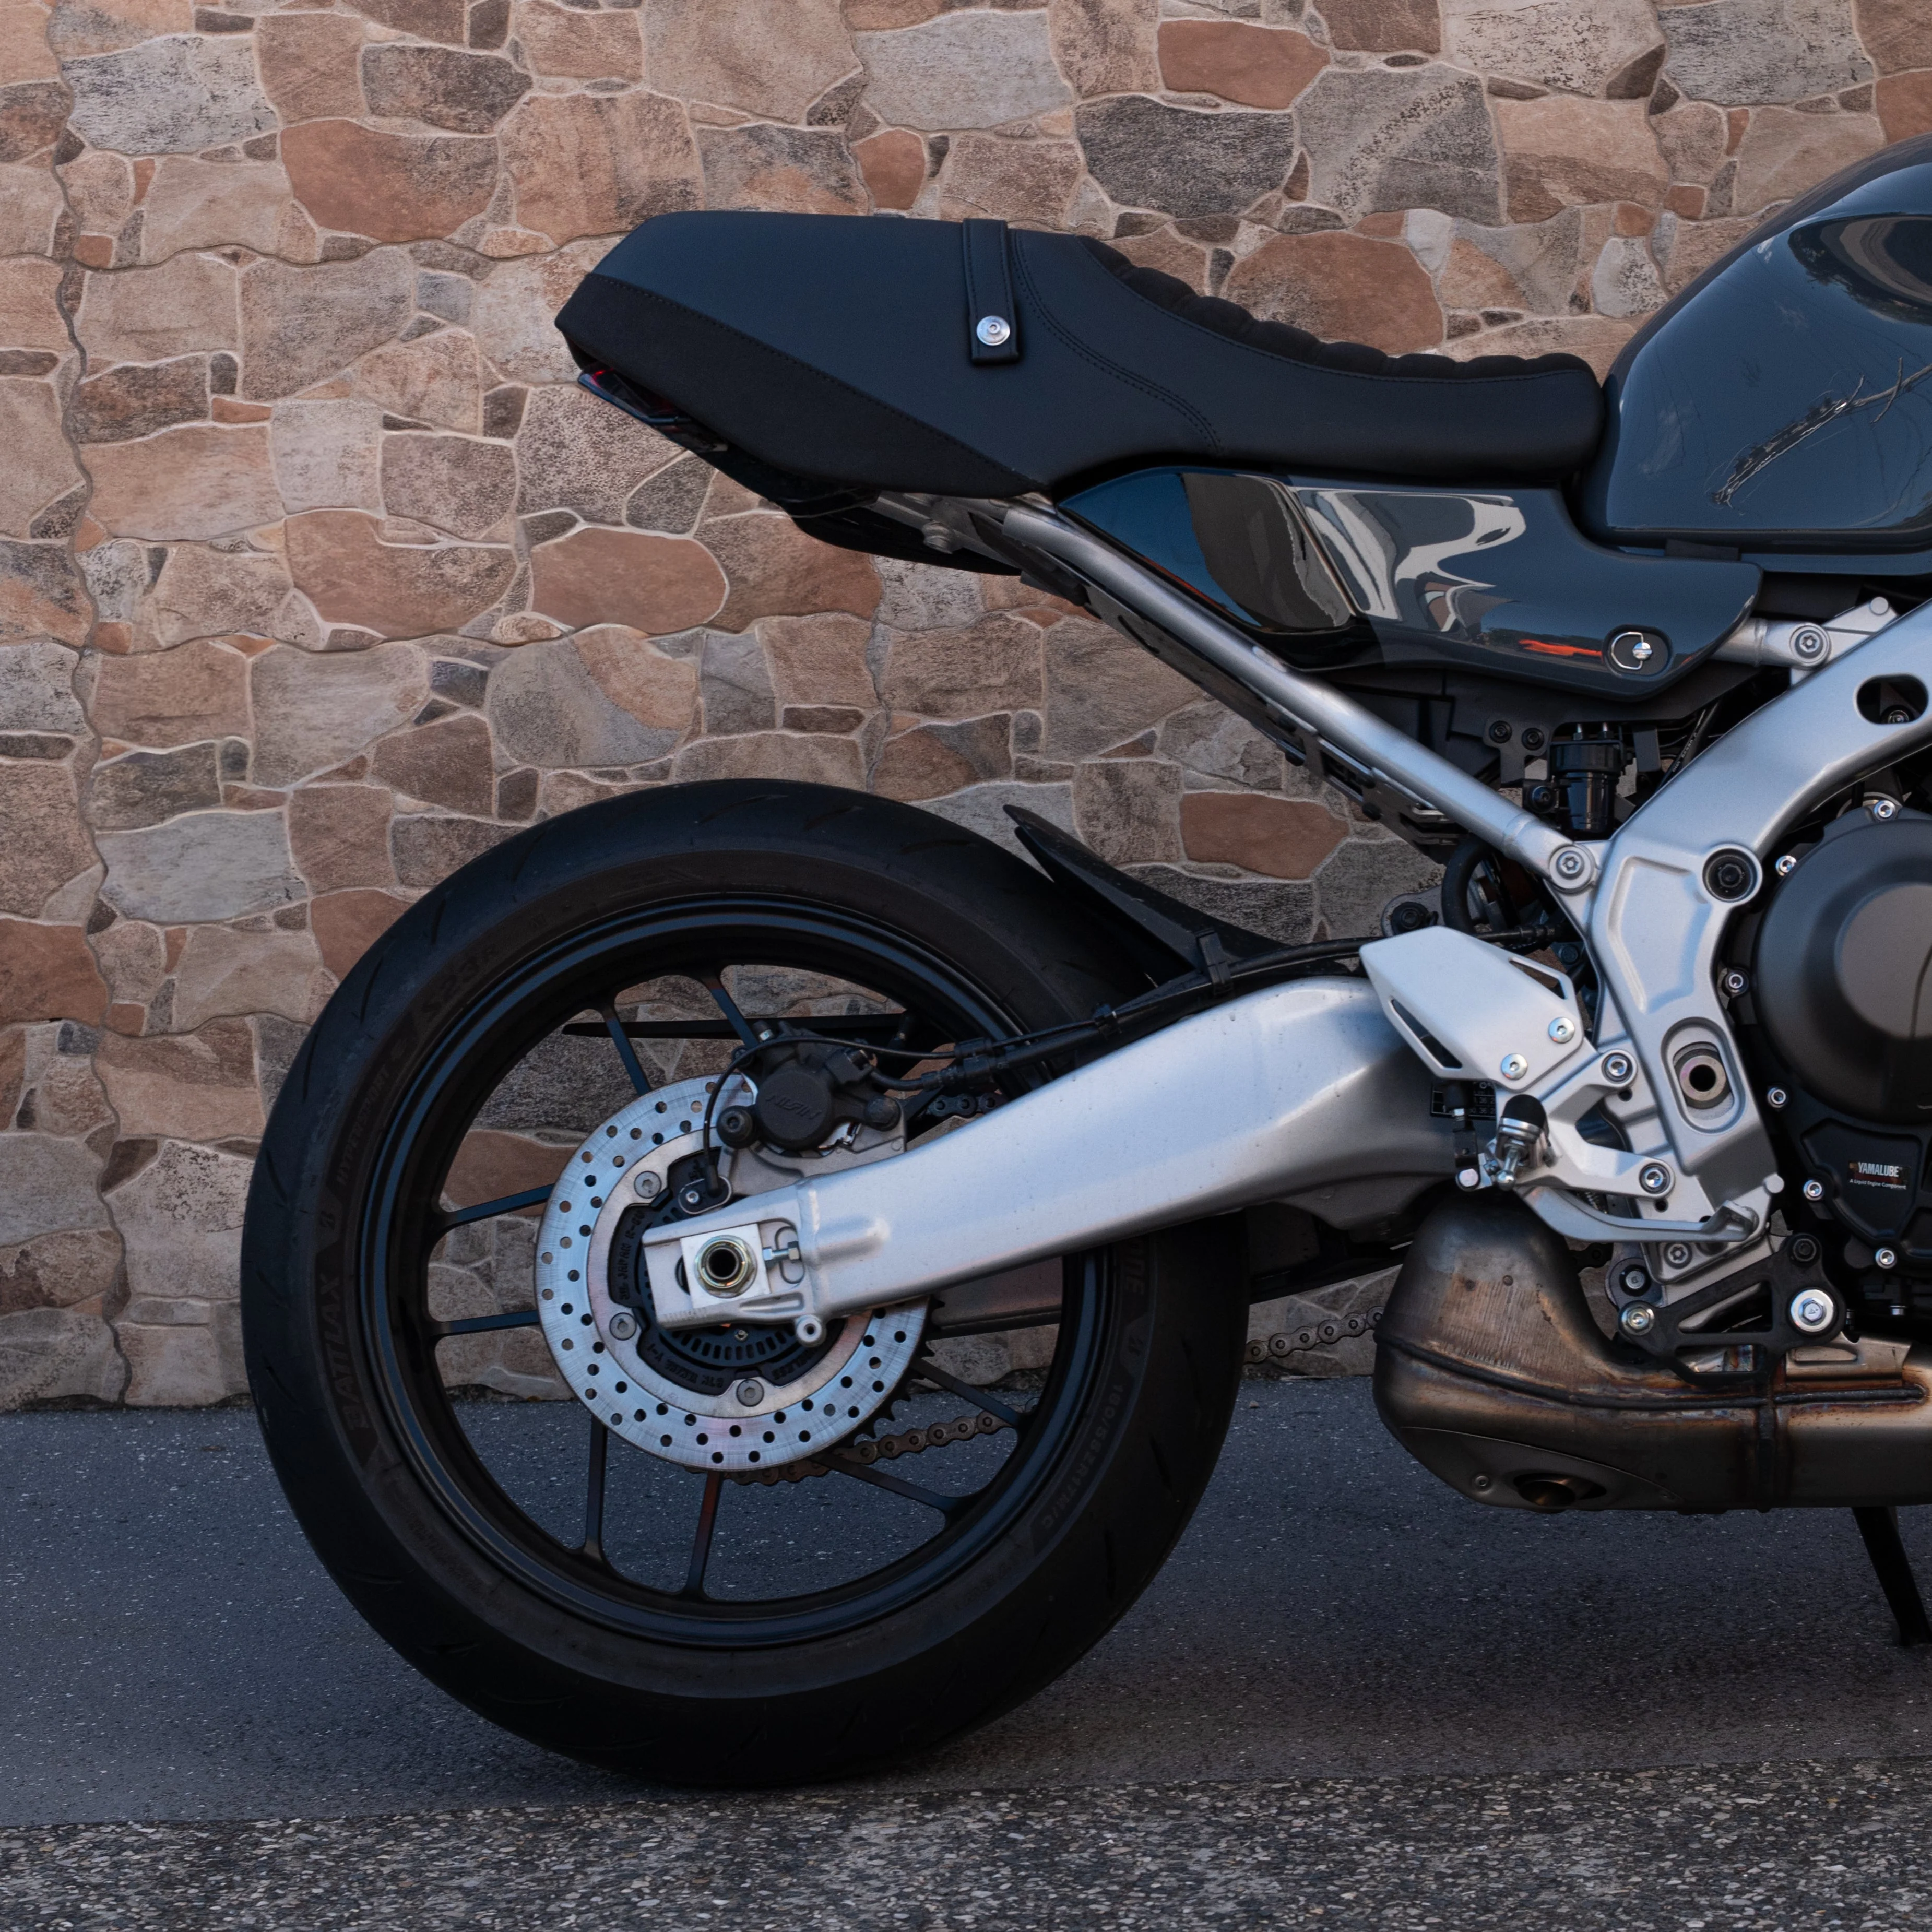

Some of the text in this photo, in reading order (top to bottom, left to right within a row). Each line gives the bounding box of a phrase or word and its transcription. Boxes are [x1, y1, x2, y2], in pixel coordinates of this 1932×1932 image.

[1857, 1162, 1899, 1177] YAMALUBE
[617, 1242, 632, 1279] JAPAN
[320, 1274, 369, 1430] BATTLAX
